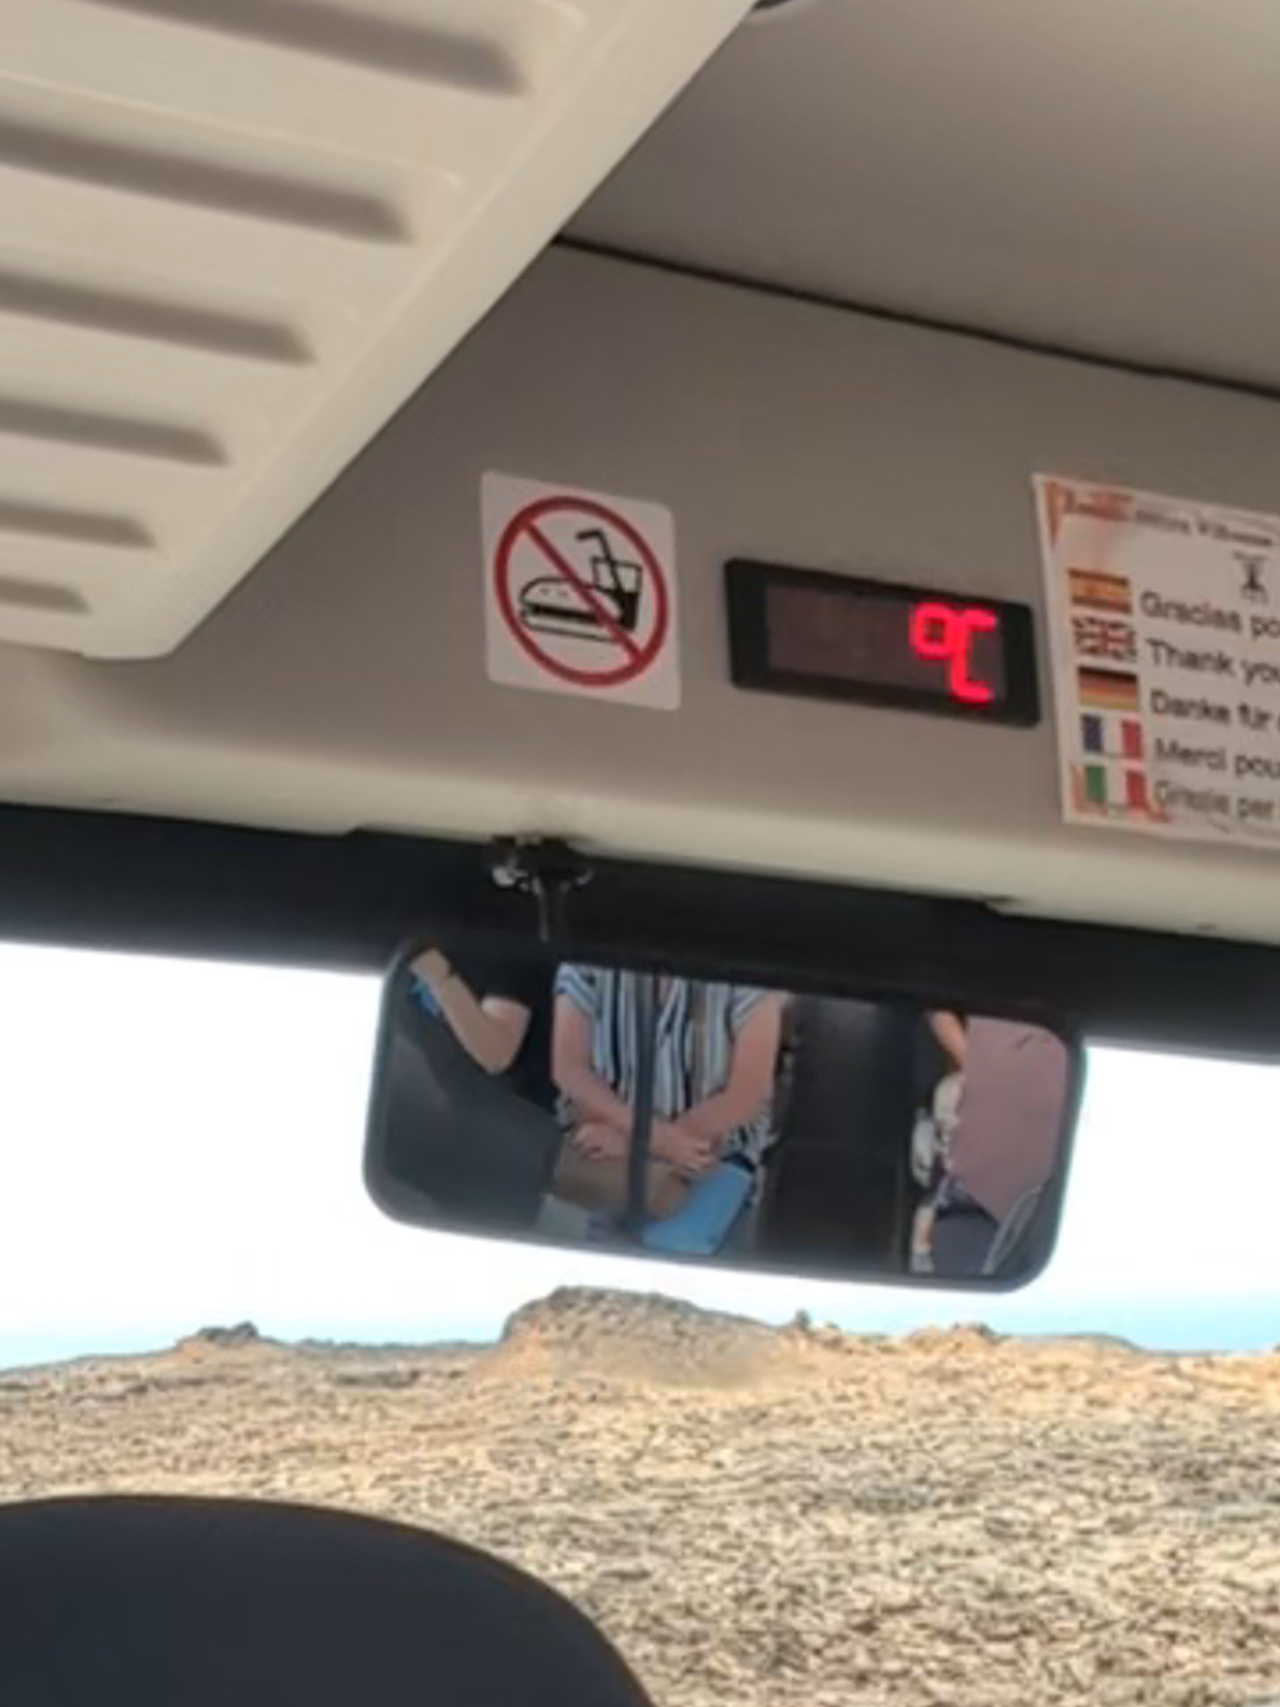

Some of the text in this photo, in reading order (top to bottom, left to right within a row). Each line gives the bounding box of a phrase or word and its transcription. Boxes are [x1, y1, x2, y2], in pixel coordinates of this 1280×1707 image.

[1139, 590, 1242, 634] Gracias
[1147, 638, 1236, 676] Thank
[1150, 689, 1231, 724] Danke
[1154, 737, 1225, 772] Merci
[1237, 793, 1275, 824] per
